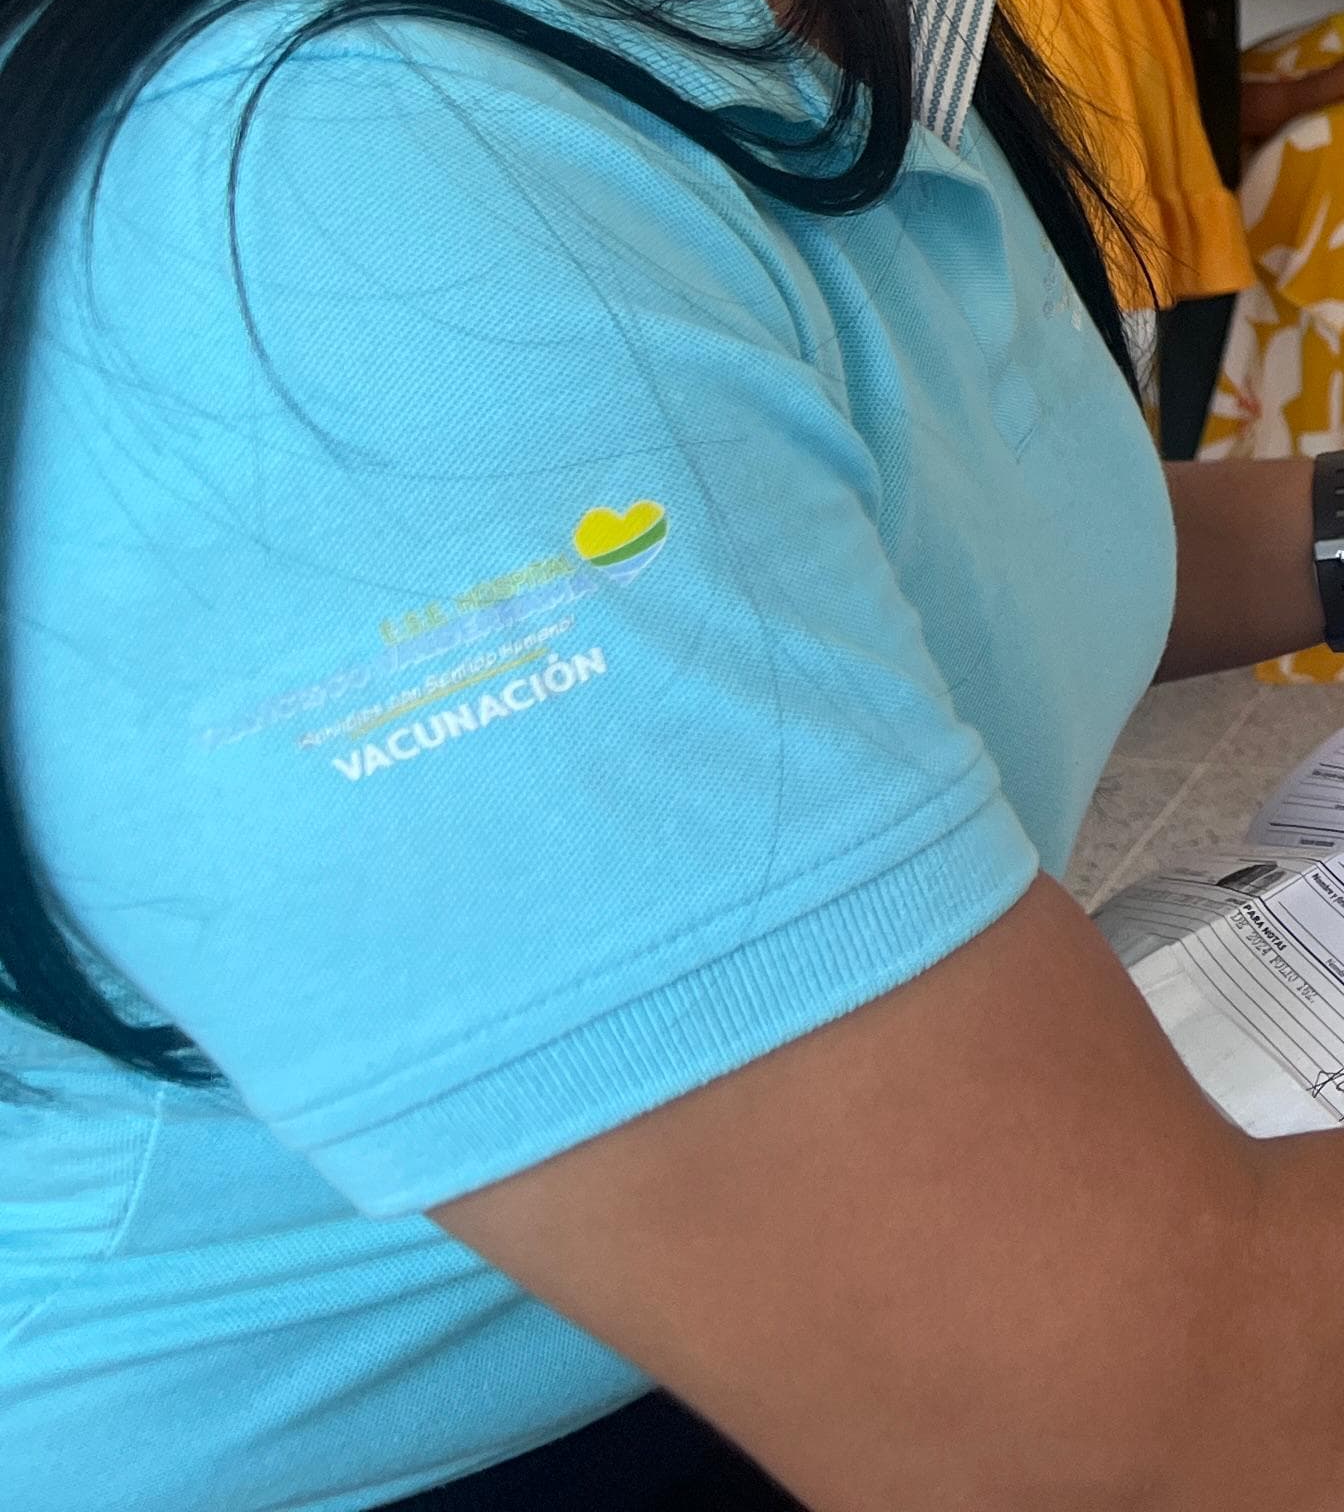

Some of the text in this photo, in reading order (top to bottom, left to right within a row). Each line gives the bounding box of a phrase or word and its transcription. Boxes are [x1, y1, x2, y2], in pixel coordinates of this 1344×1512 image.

[331, 647, 607, 782] VACUNACIÓN
[1239, 902, 1288, 952] PARA NOTAS
